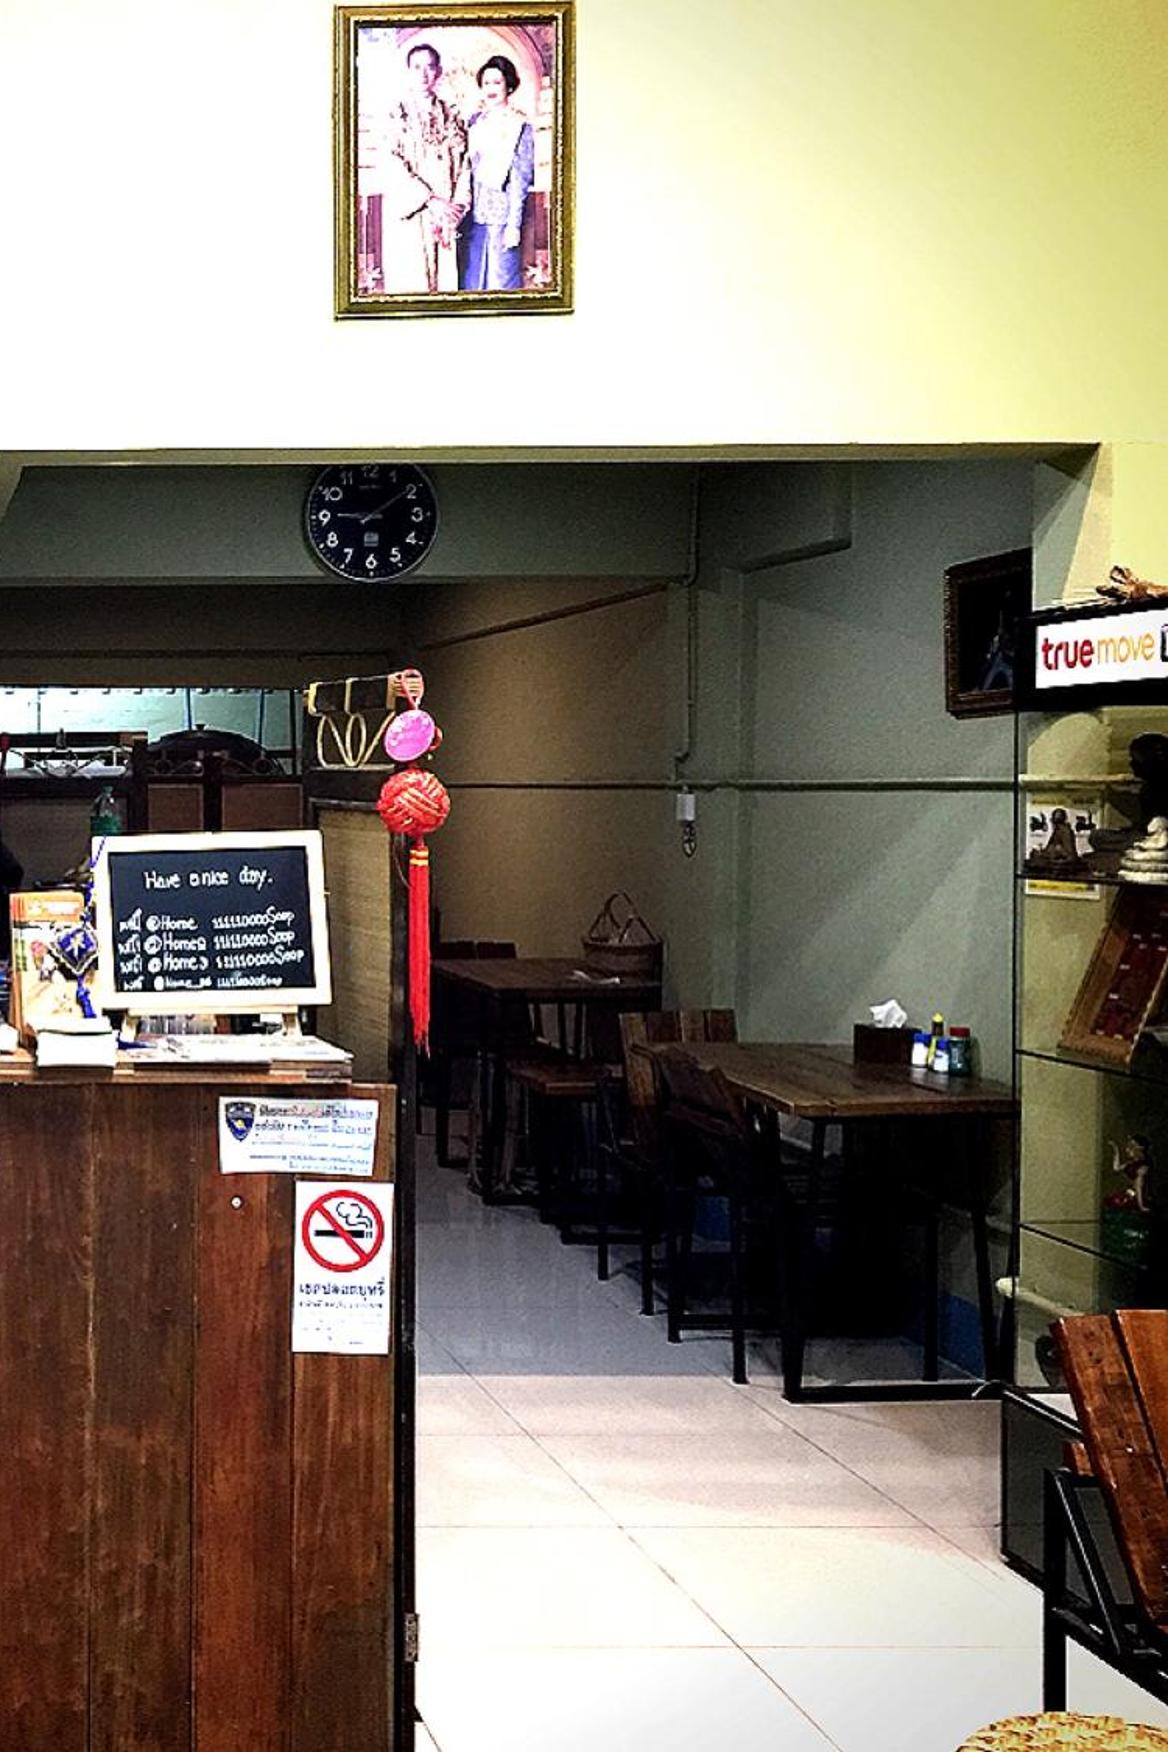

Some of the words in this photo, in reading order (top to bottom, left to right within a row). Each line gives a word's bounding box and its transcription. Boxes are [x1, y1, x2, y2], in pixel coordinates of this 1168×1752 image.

[340, 471, 353, 485] 11
[389, 470, 397, 483] 1
[322, 487, 343, 501] 10
[406, 484, 417, 499] 2
[318, 509, 331, 526] 9
[411, 507, 423, 522] 3
[326, 532, 338, 547] 8
[405, 532, 417, 544] 4
[343, 548, 353, 564] 7
[365, 554, 377, 569] 6
[389, 548, 401, 563] 5
[144, 870, 180, 889] Have
[202, 870, 229, 887] nice
